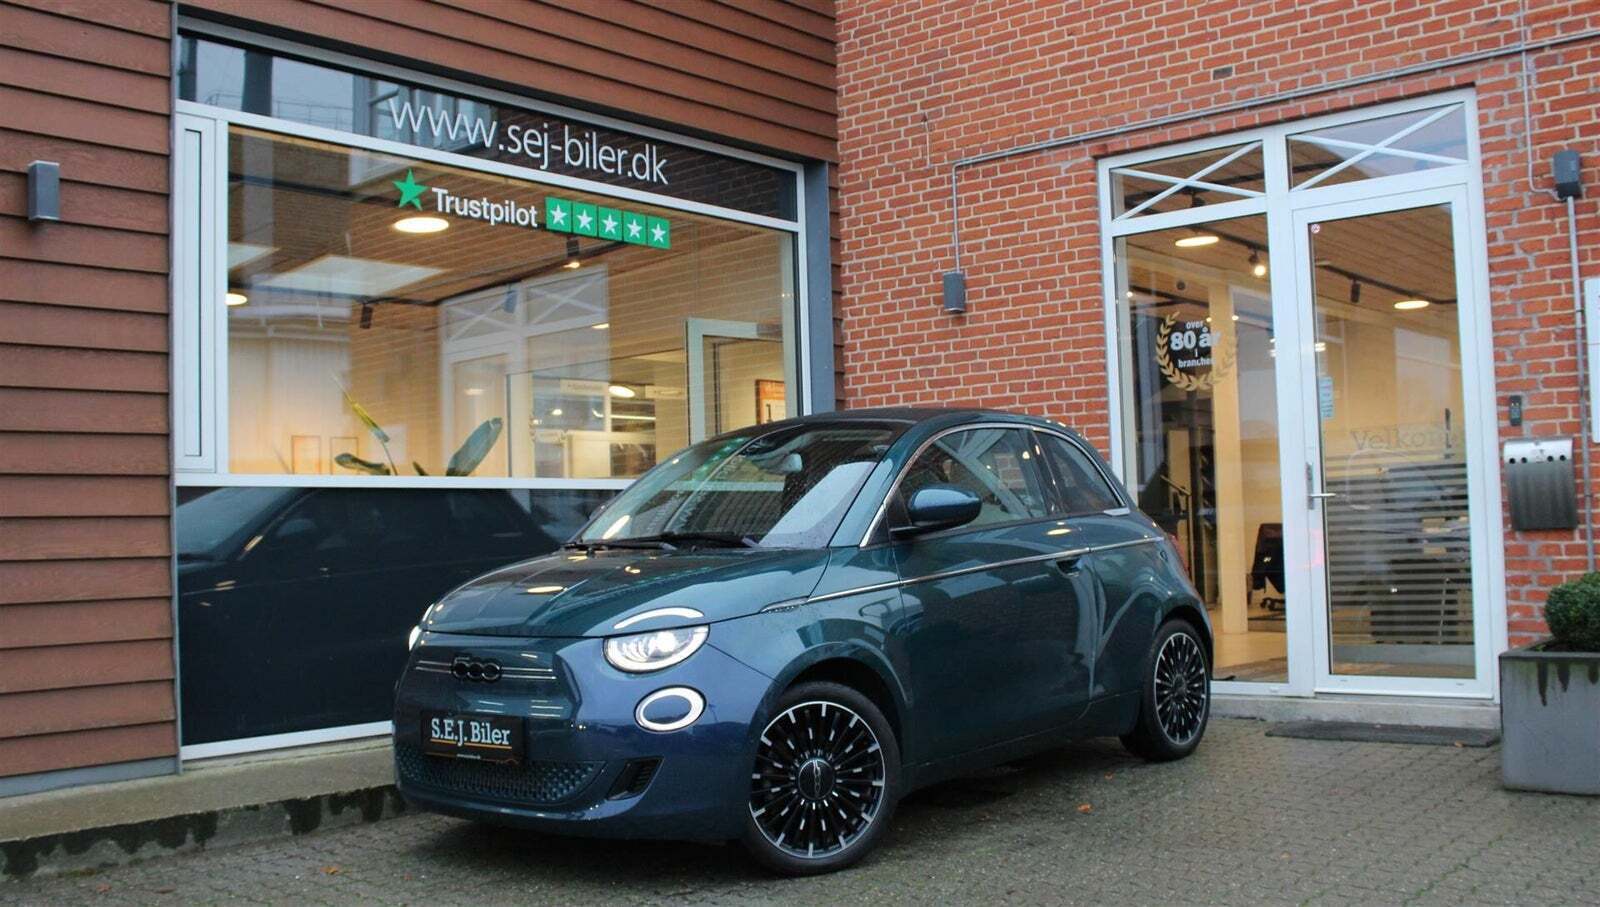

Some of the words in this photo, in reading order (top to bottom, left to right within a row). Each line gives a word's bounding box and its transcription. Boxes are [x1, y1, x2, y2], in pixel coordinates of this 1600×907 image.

[389, 98, 669, 185] www.sej-biler.dk
[432, 187, 538, 227] Trustpilot
[1186, 321, 1204, 329] over
[1170, 331, 1196, 350] 80
[1199, 328, 1220, 347] år
[453, 656, 501, 681] 500
[431, 717, 468, 747] S.E.J.
[470, 721, 511, 745] Biler
